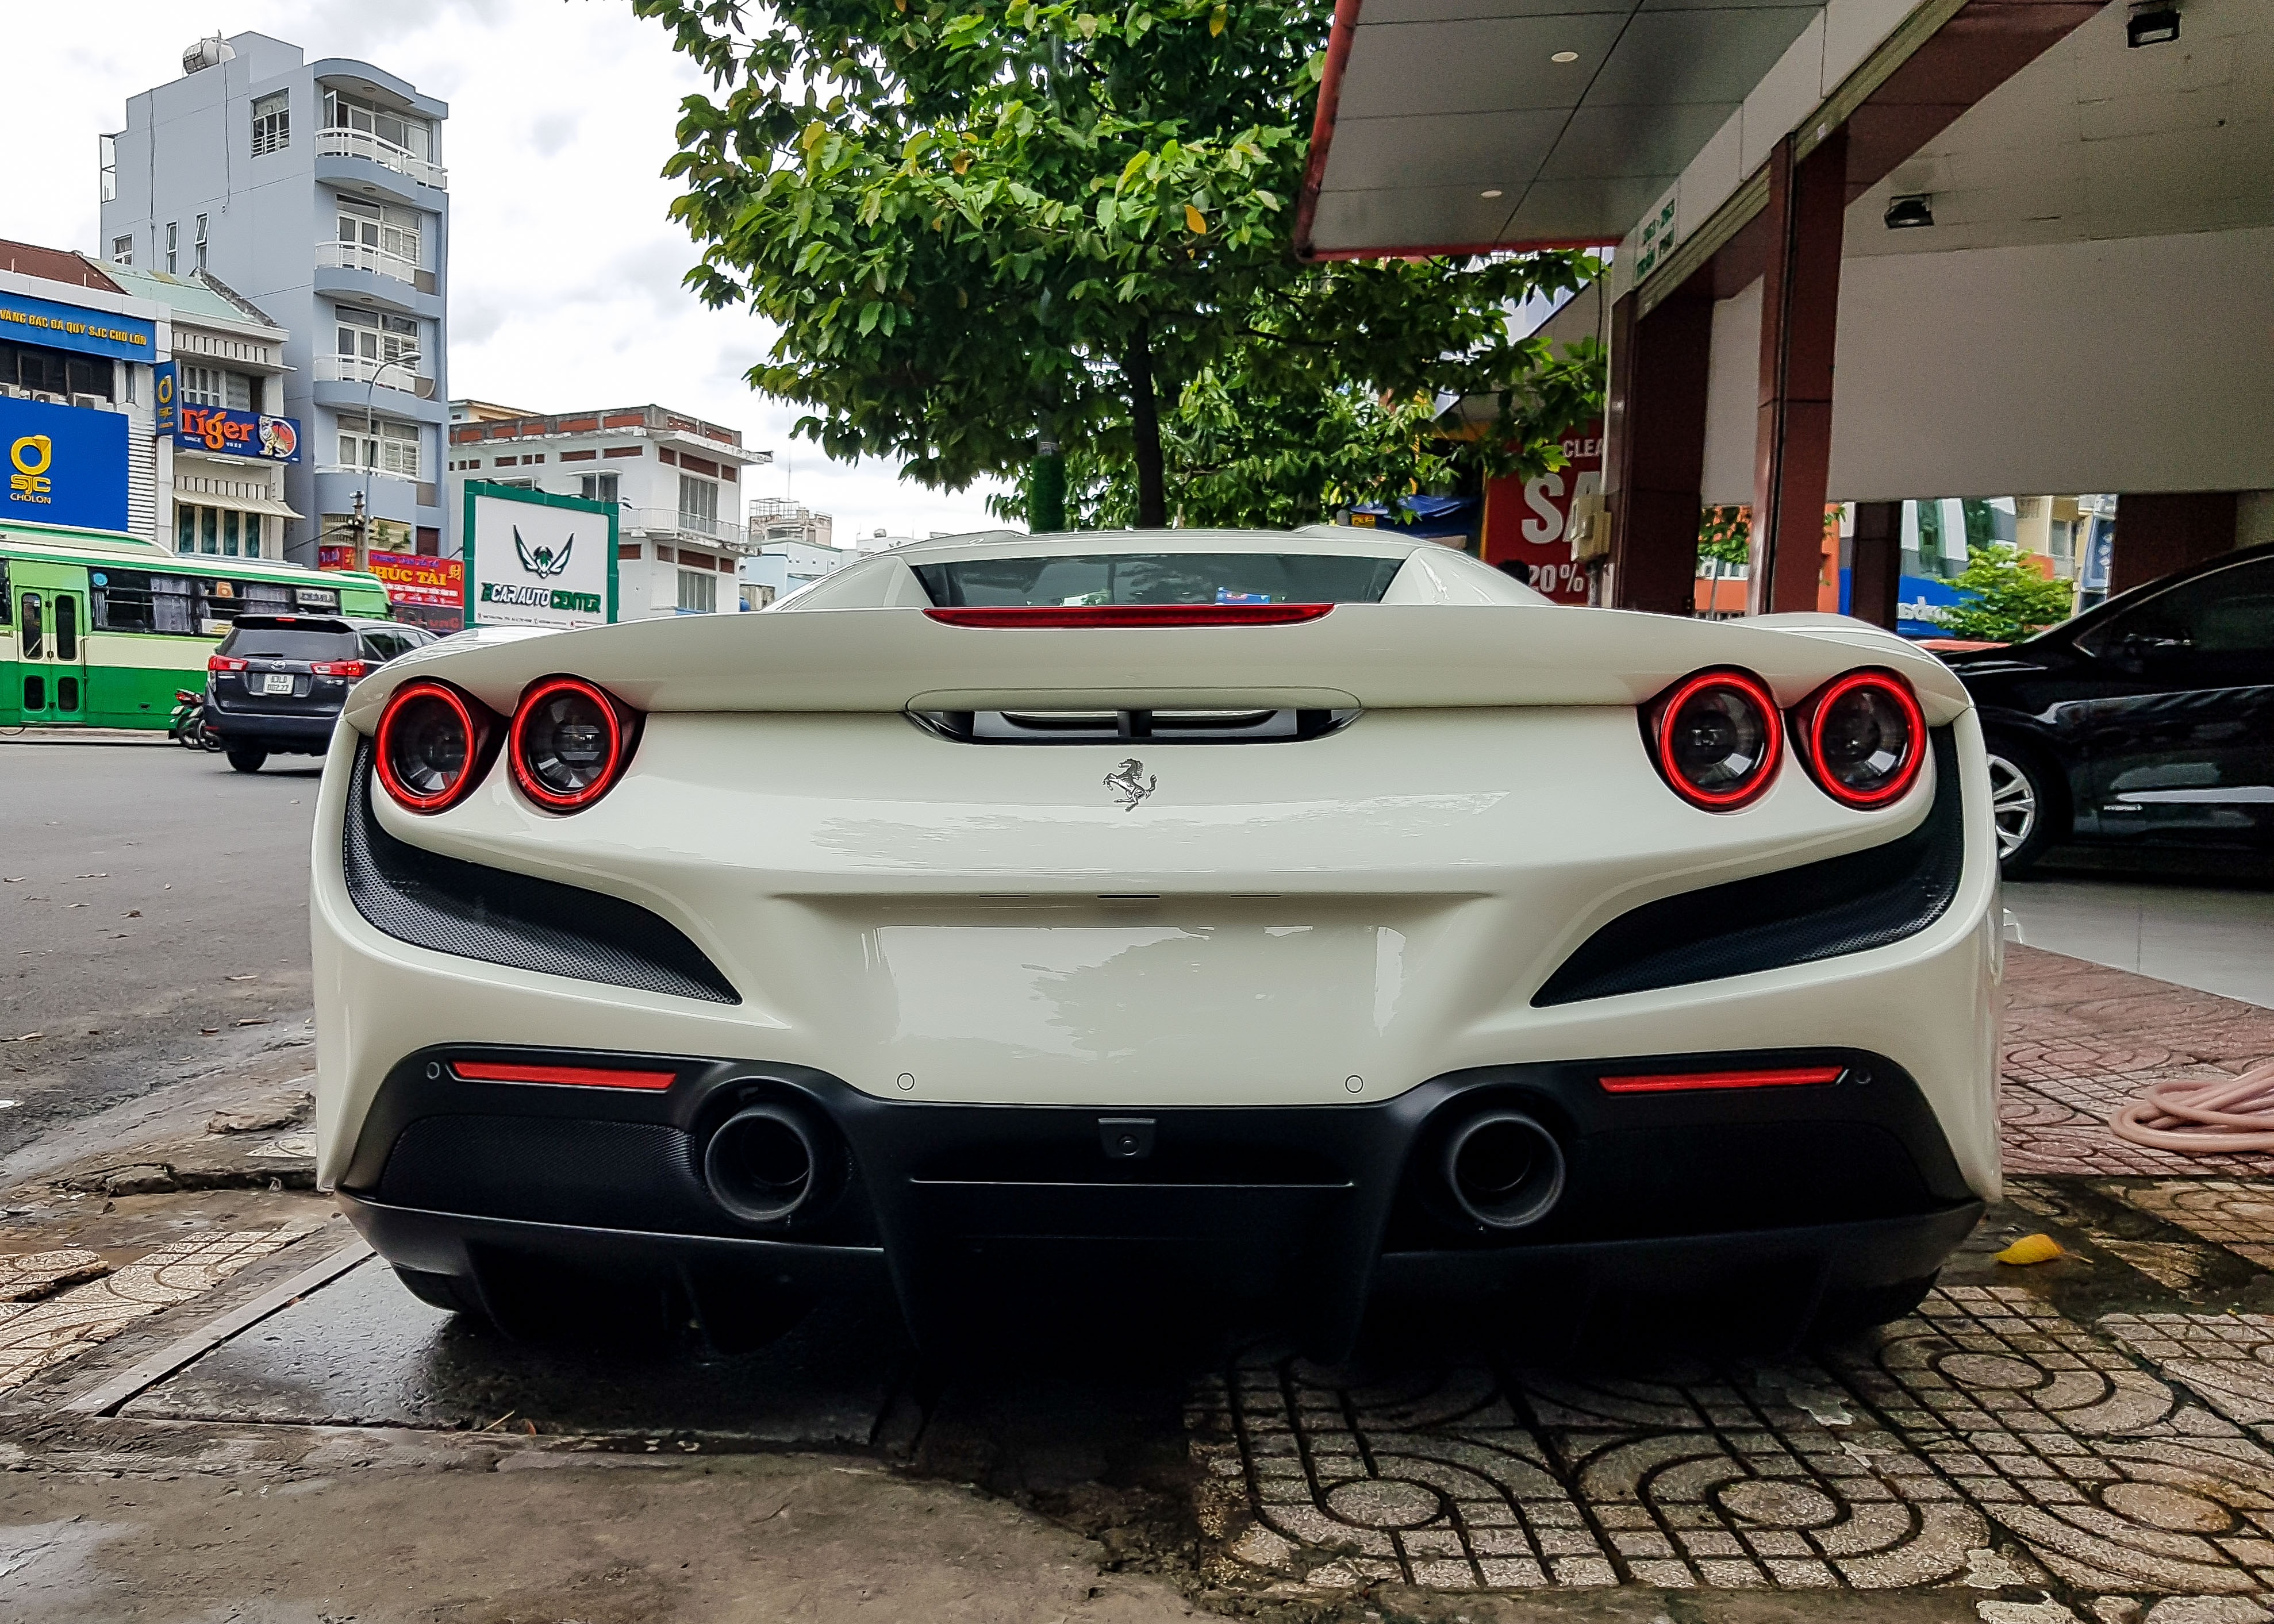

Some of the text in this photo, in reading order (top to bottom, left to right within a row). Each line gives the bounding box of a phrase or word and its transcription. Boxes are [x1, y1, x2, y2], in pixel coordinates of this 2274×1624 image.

[181, 407, 255, 449] Tiger
[10, 474, 51, 494] SJC
[10, 492, 51, 505] CHOLON
[416, 568, 447, 587] TÀI
[517, 586, 550, 607] AUTO
